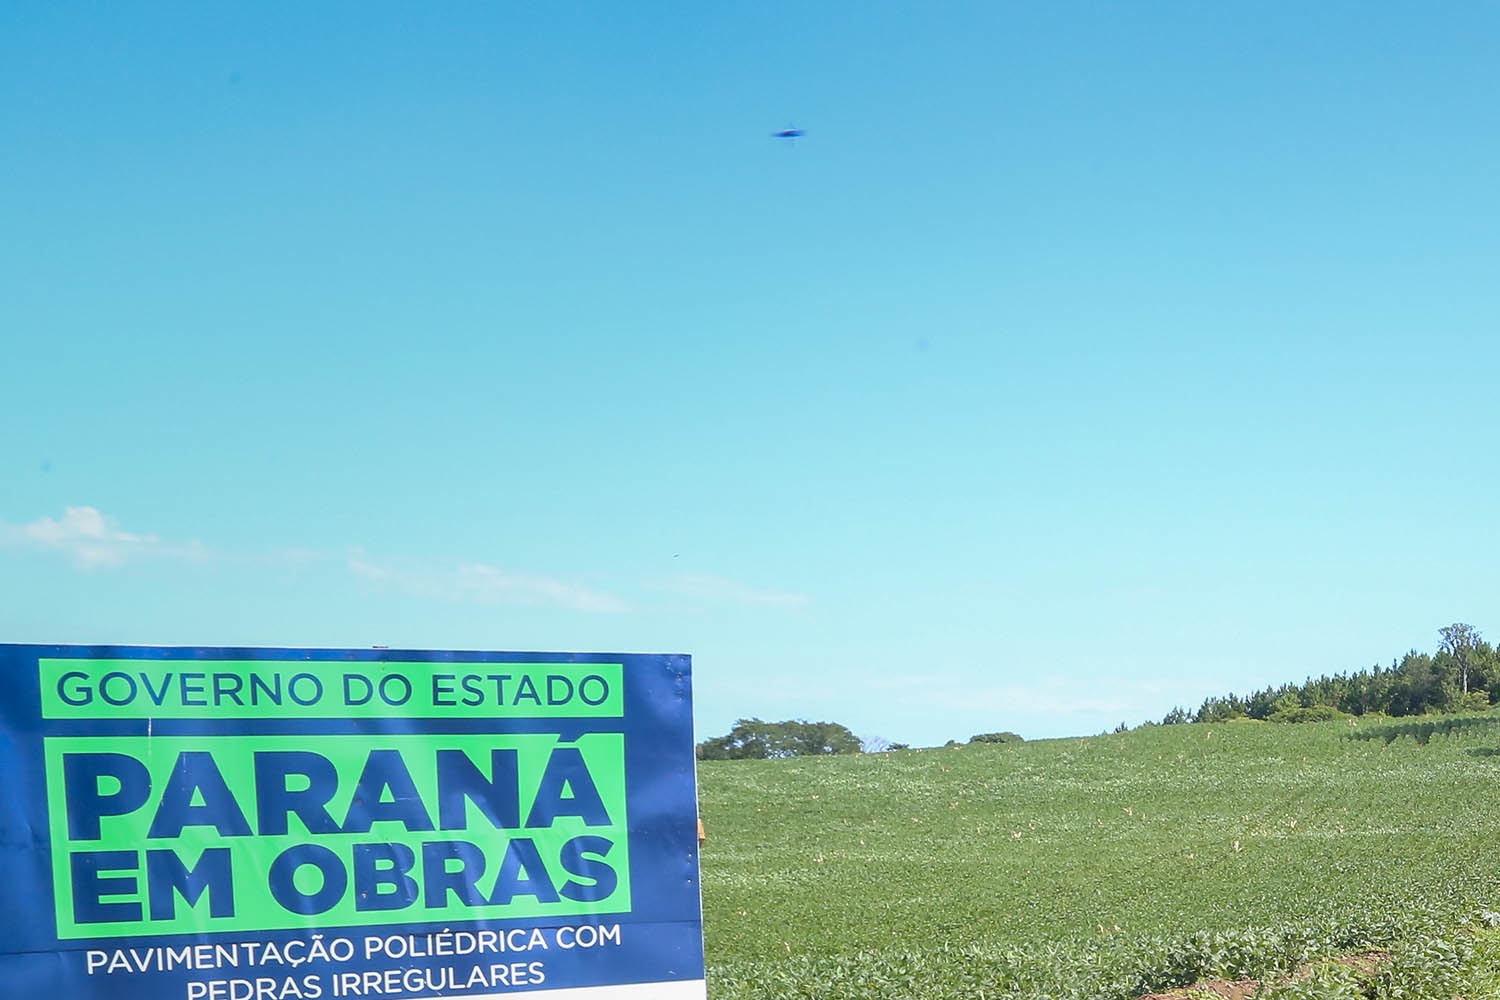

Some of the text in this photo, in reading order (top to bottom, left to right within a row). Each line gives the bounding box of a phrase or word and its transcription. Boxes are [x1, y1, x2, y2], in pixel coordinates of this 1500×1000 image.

[57, 671, 609, 706] GOVERNO DO ESTADO
[63, 733, 613, 841] PARANÁ
[70, 835, 618, 924] EM OBRAS
[87, 924, 621, 975] PAVIMENTAÇÃO POLIÉDRICA COM
[333, 961, 545, 997] IRREGULARES
